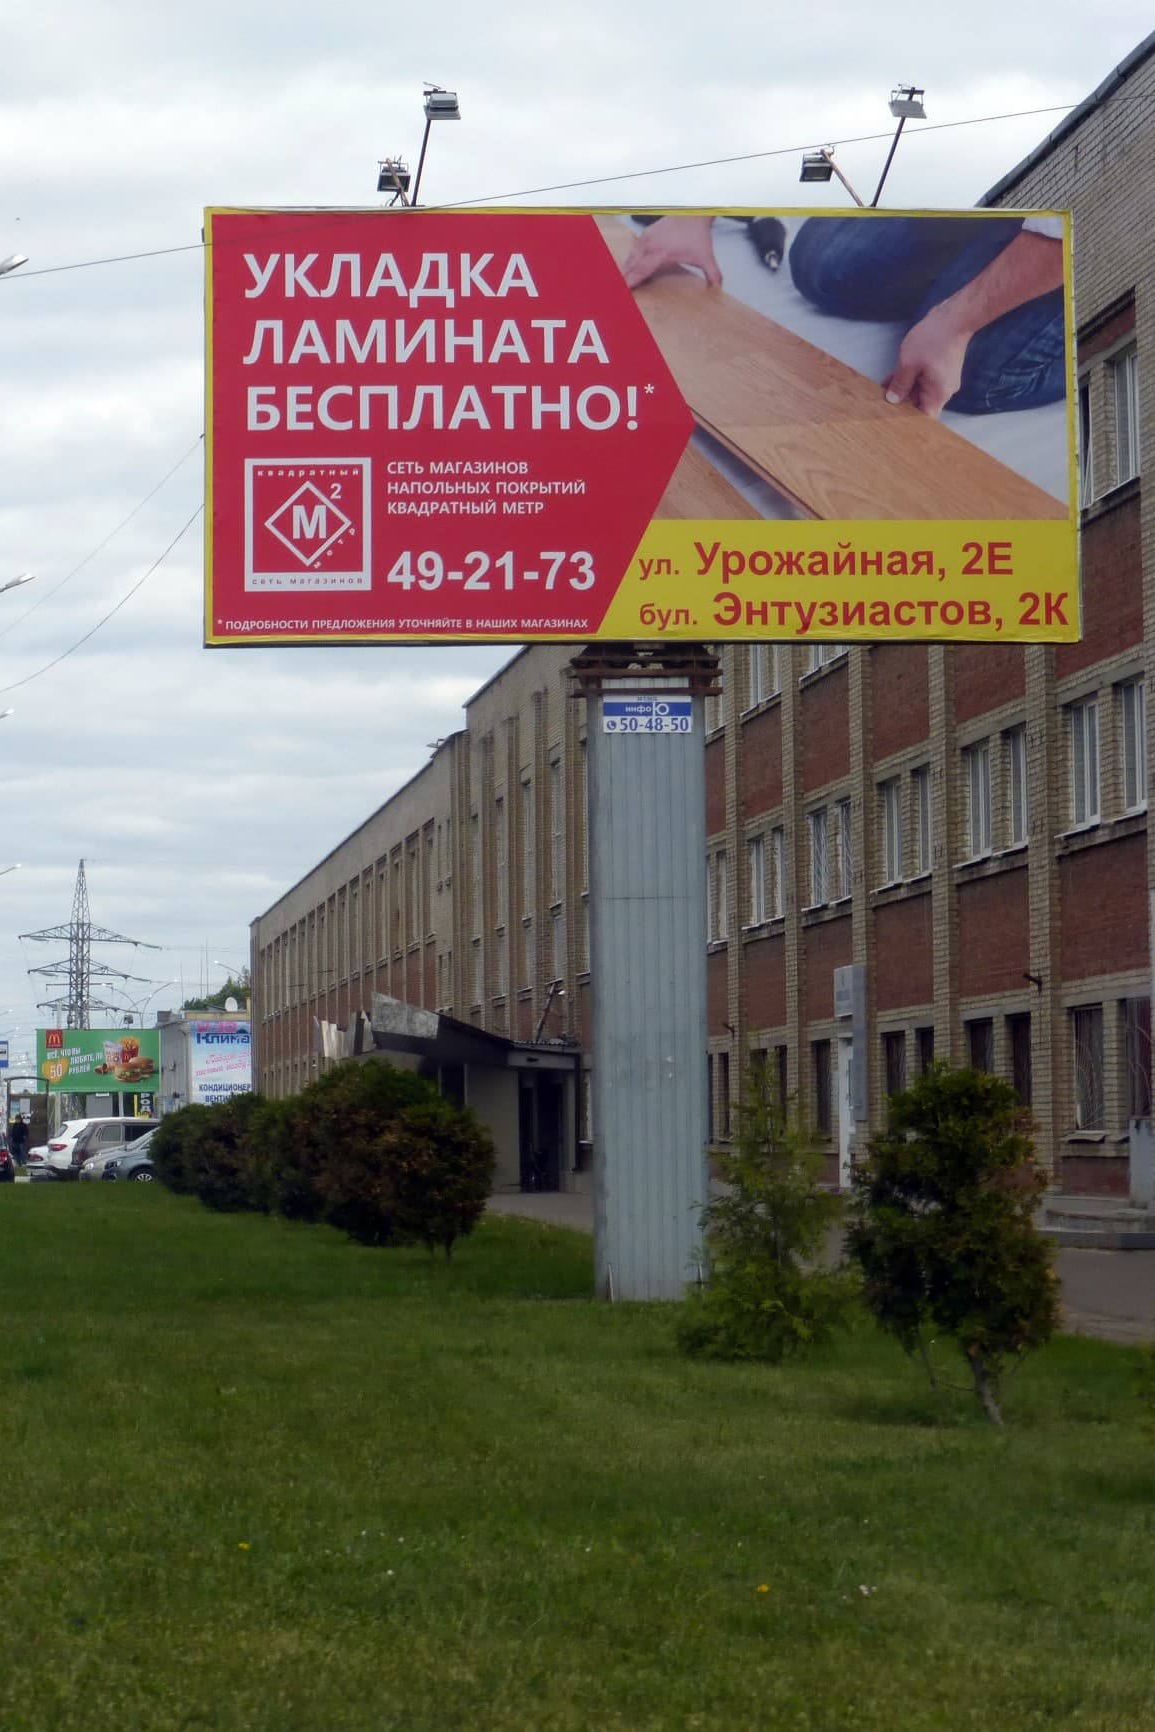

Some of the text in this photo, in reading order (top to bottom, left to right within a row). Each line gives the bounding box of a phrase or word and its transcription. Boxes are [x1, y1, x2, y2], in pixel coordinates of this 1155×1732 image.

[243, 253, 539, 308] УКЛАДКА
[243, 319, 610, 364] ЛАМИНАТА
[257, 468, 359, 477] квадратный
[387, 462, 528, 474] СЕТЬ МАГАЗИНОВ
[387, 479, 586, 494] НАПОЛЬНЫХ ПОКРЫТИЙ
[387, 499, 544, 516] КВАДРАТНЫЙ МЕТР
[639, 541, 1014, 583] ул. Урожайная, 2Е
[387, 551, 595, 590] 49-21-73
[290, 577, 363, 585] магазинов
[639, 592, 1069, 634] бул. Энтузиастов, 2К
[312, 619, 395, 629] ПРЕДЛОЖЕНИЯ
[398, 616, 462, 629] УТОЧНЯЙТЕ
[466, 619, 472, 628] В
[476, 619, 517, 628] НАШИХ
[521, 618, 588, 628] МАГАЗИНАХ
[619, 717, 689, 732] 50-48-50
[50, 1063, 63, 1079] 50
